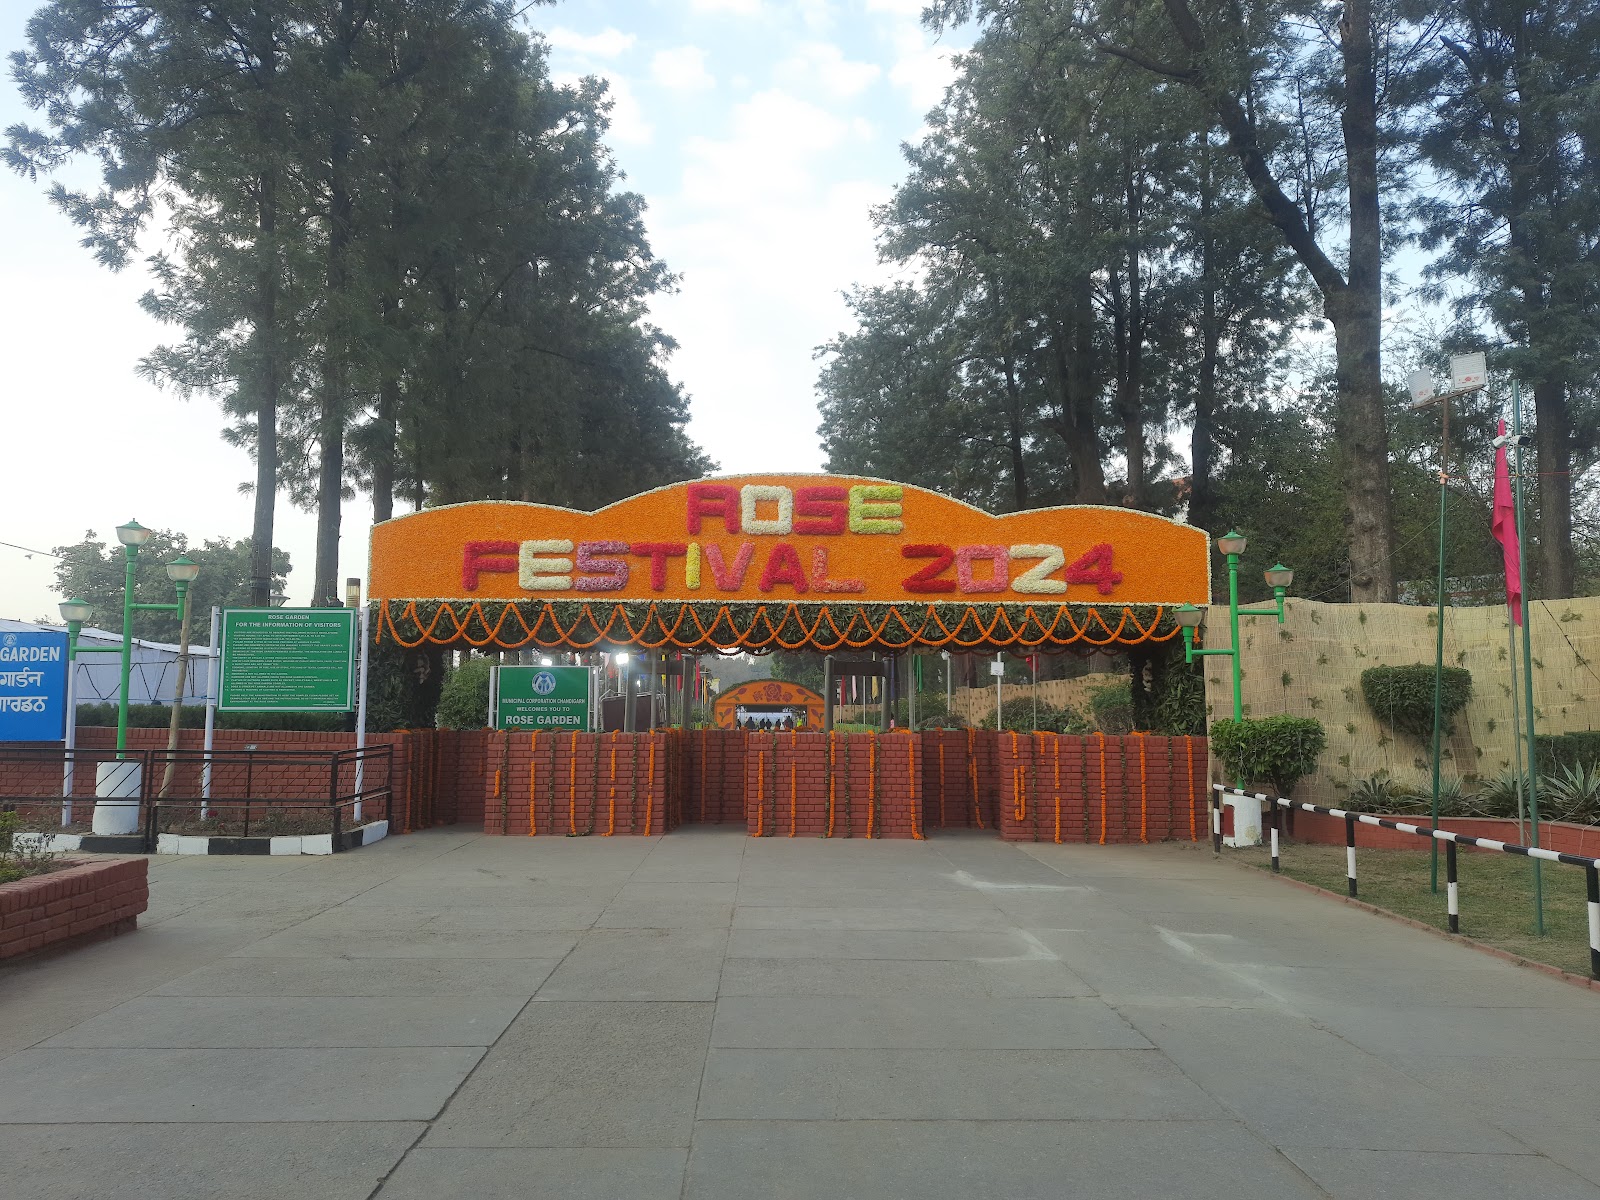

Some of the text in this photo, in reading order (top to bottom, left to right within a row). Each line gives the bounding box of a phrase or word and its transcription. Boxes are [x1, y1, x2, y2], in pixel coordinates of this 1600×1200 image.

[687, 484, 903, 535] ROSE
[462, 539, 1123, 594] FESTIVAL 2024
[0, 646, 60, 661] GARDEN
[506, 716, 580, 724] ROSE GARDEN
